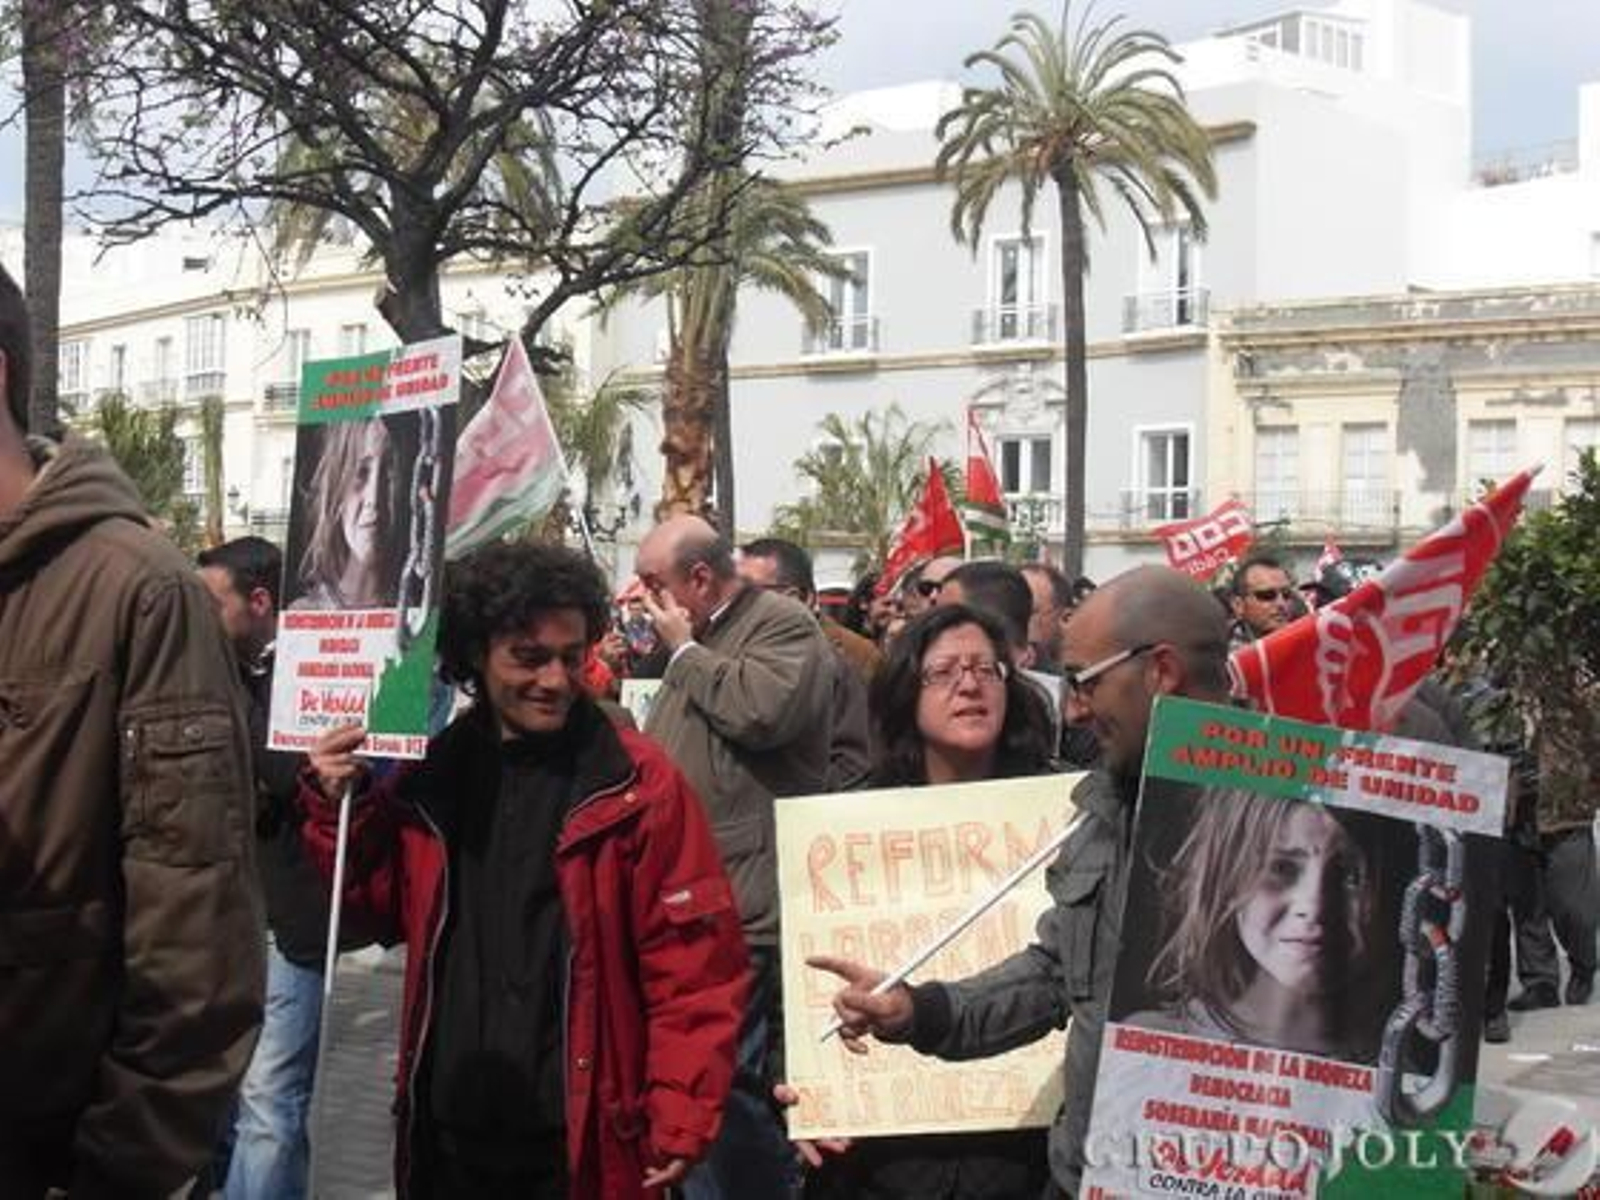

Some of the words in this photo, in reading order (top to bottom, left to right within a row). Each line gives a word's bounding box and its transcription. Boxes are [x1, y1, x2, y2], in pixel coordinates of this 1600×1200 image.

[1202, 721, 1268, 747] POR
[1279, 738, 1325, 758] UN
[1334, 746, 1458, 784] FRENTE
[1171, 745, 1296, 779] AMPLIO
[1308, 765, 1348, 790] DE
[1360, 775, 1480, 814] UNIDAD
[1278, 1055, 1299, 1078] LA
[1189, 1073, 1292, 1108] DEMOCRACIA
[1150, 1174, 1221, 1198] CONTRA
